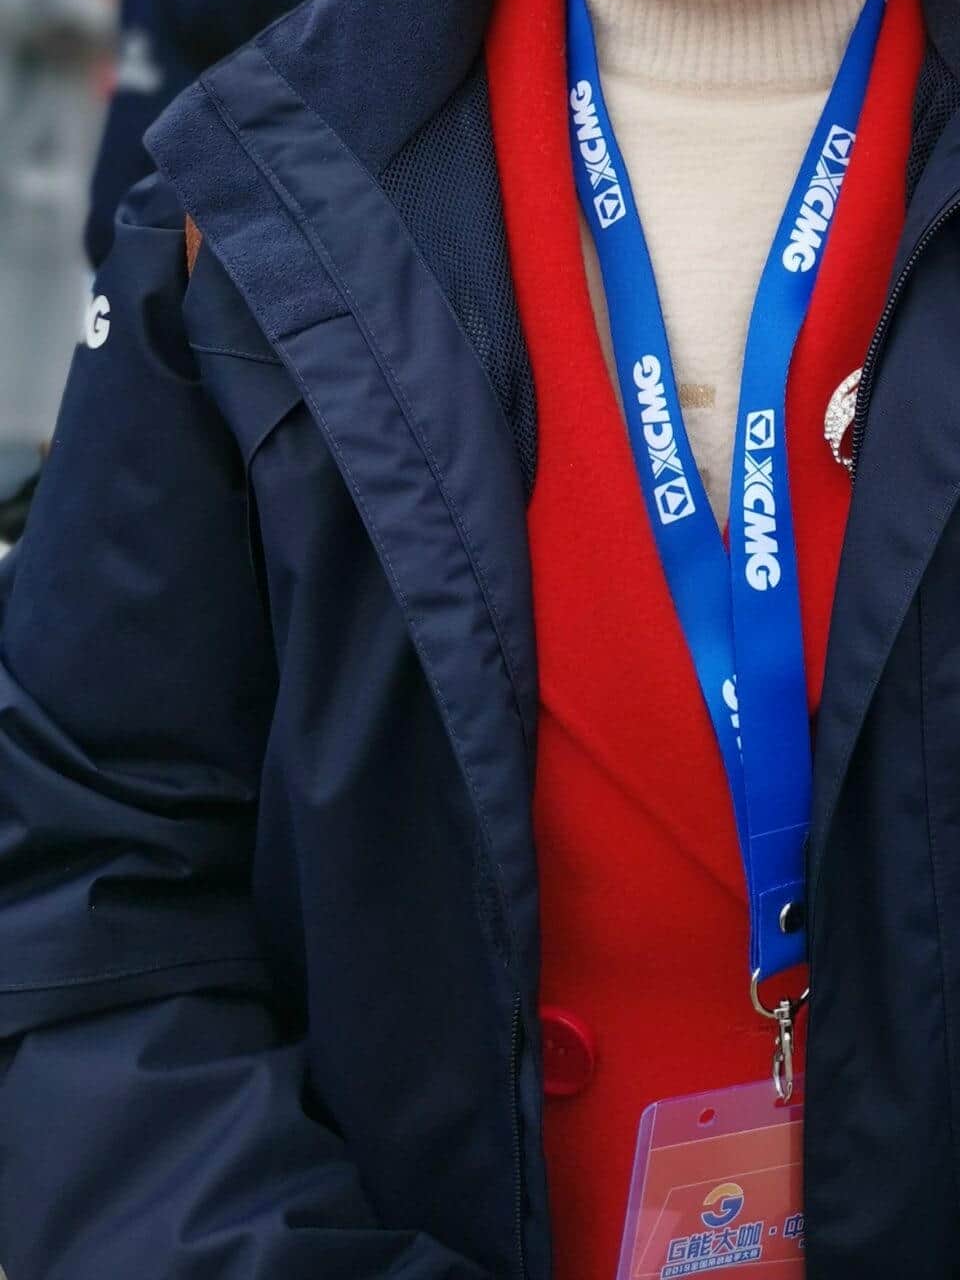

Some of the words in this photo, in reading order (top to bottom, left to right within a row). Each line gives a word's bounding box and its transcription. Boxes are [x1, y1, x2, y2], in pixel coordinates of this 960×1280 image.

[570, 80, 618, 190] XCMG
[782, 155, 846, 273] XCMG
[633, 354, 684, 480] XCMG
[743, 451, 781, 591] XCMG
